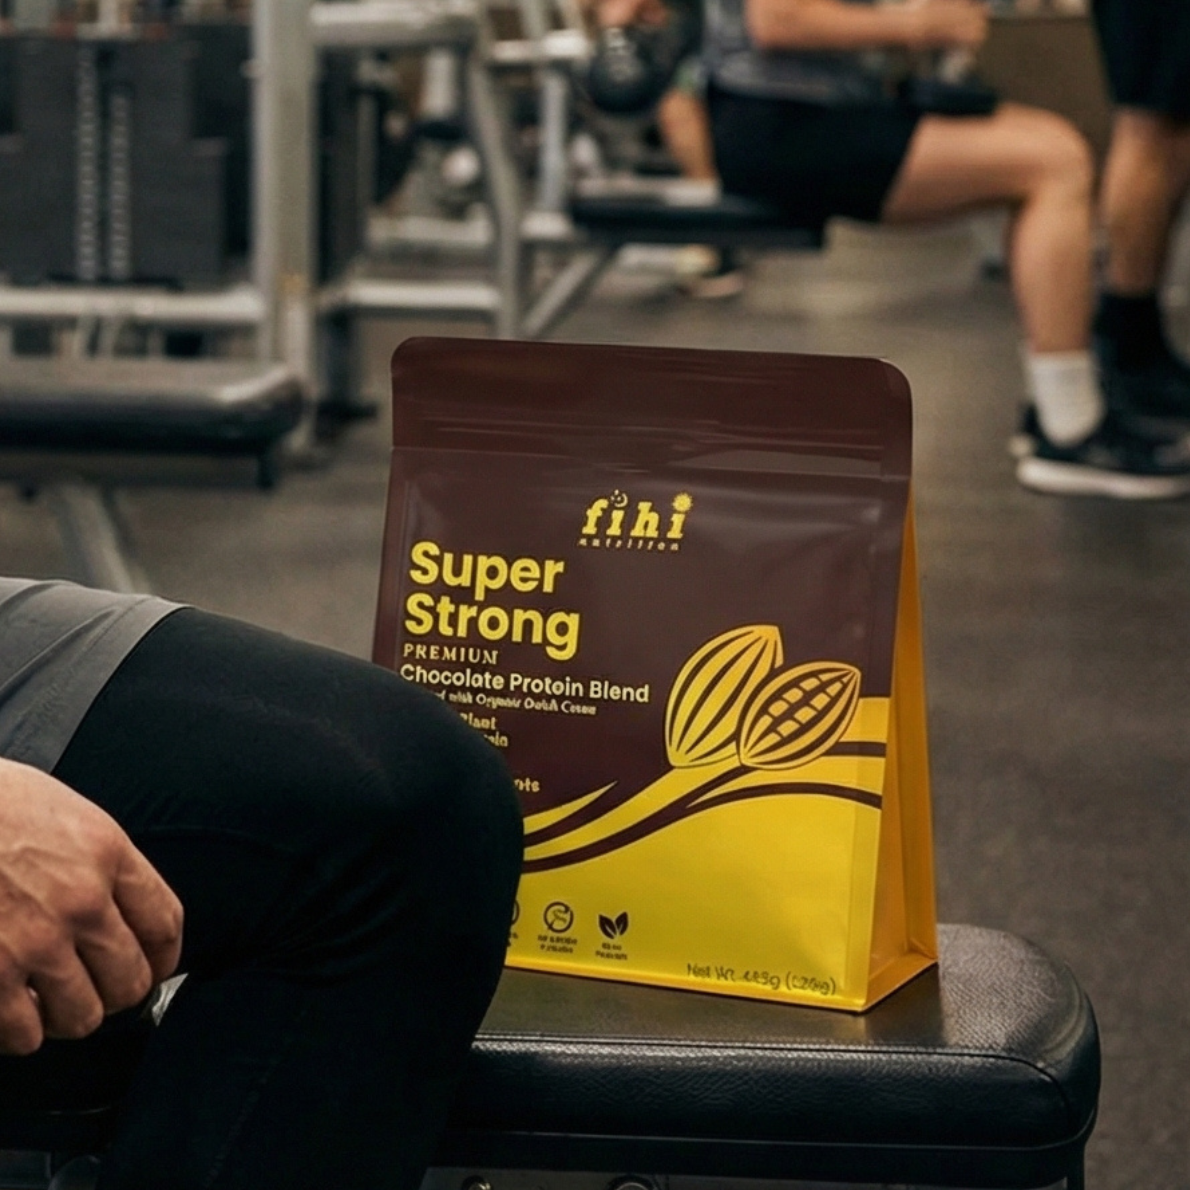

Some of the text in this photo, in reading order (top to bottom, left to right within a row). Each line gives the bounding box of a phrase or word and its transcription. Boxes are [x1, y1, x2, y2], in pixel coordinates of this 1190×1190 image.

[581, 490, 693, 539] fihi
[410, 541, 565, 601] Super
[405, 592, 580, 661] Strong
[400, 663, 505, 690] Chocolate
[589, 680, 650, 703] Blend
